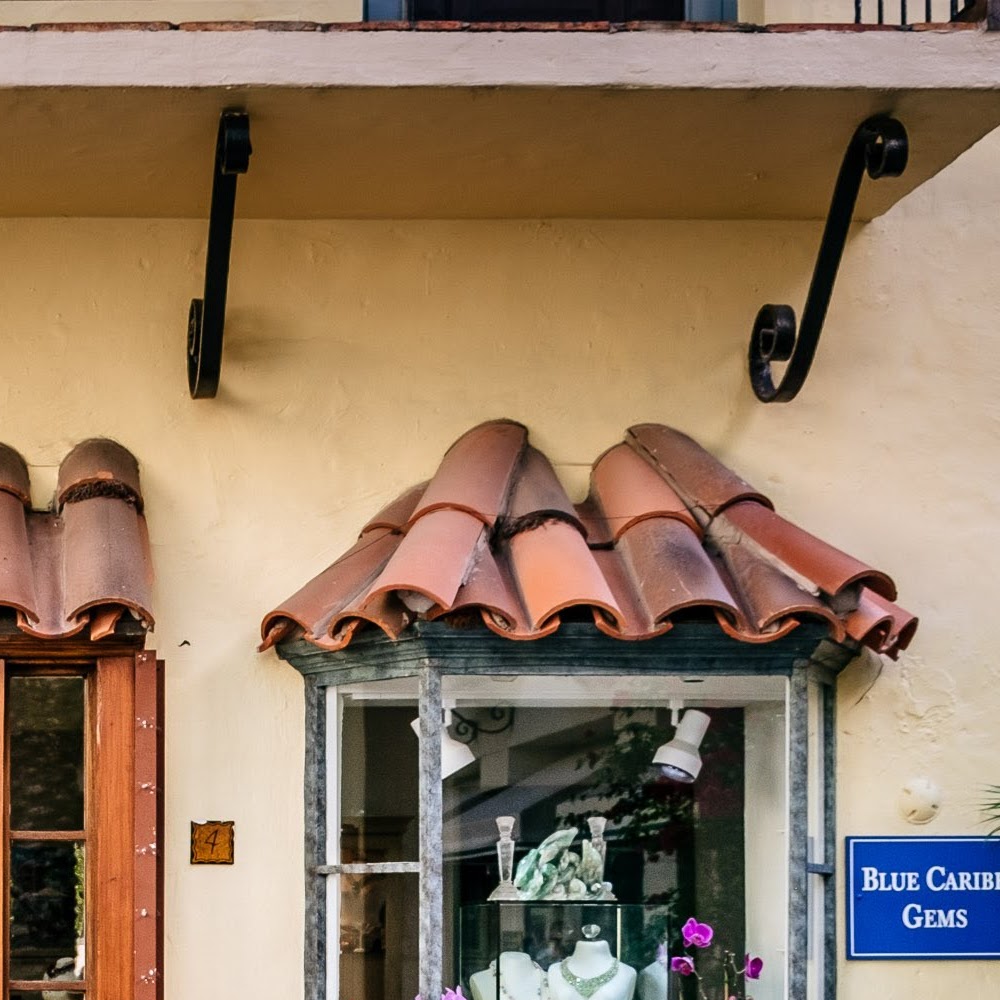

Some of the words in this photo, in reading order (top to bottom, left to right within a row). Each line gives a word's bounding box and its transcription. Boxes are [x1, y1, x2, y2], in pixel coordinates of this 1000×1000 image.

[204, 829, 220, 855] 4
[861, 866, 921, 892] BLUE
[901, 903, 969, 930] GEMS
